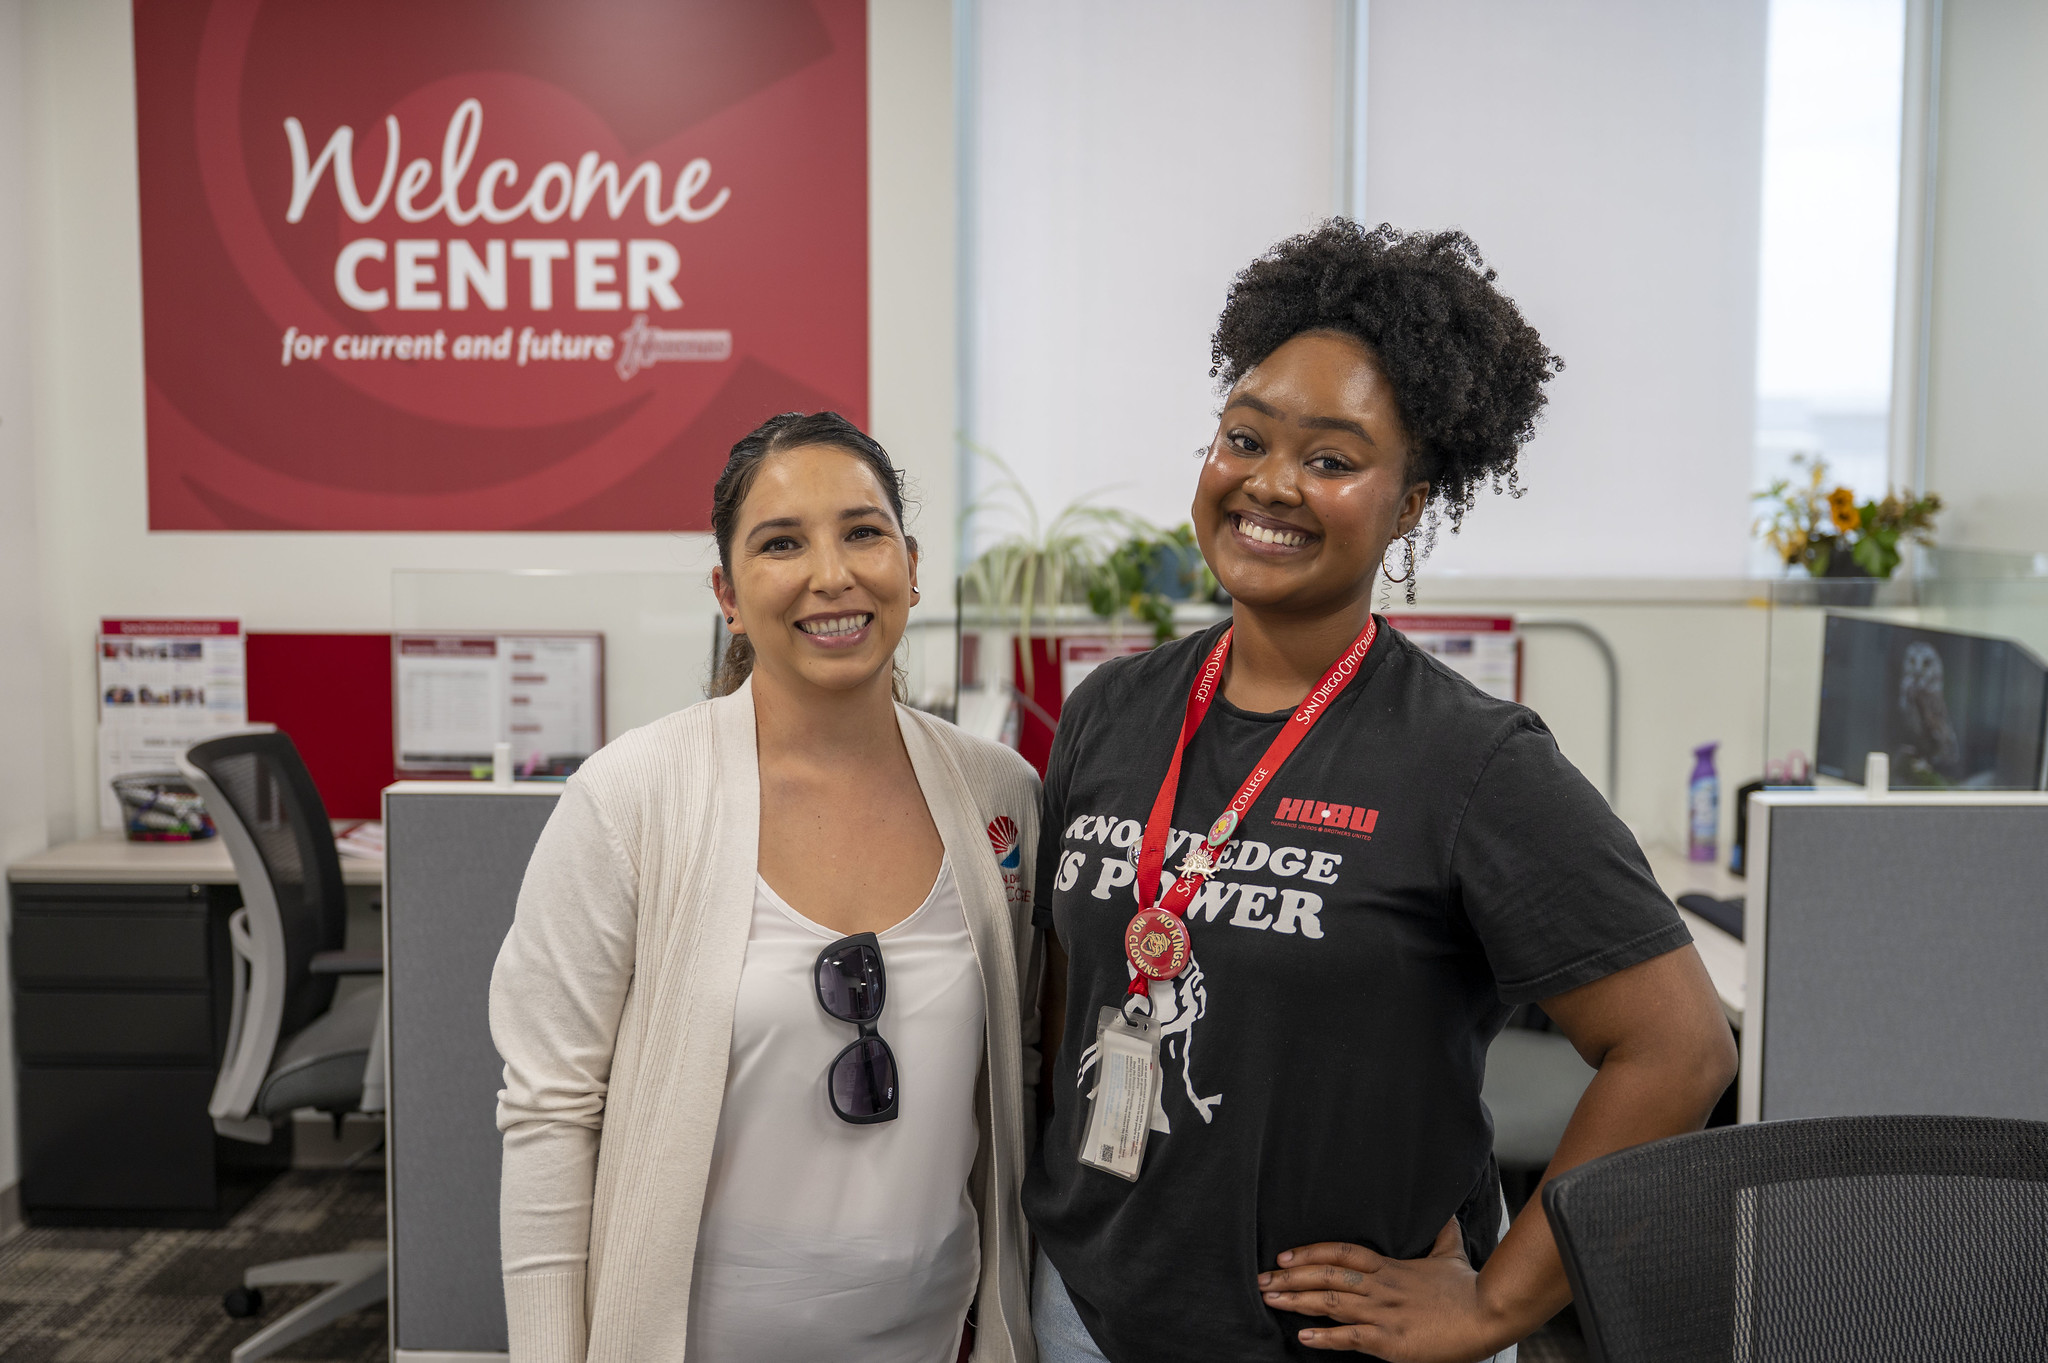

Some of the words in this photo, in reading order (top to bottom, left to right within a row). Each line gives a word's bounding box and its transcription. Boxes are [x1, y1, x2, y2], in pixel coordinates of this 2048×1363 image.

[283, 98, 732, 226] Welcome
[334, 238, 684, 311] CENTER
[281, 327, 329, 365] for
[332, 330, 447, 360] current
[451, 327, 514, 360] and
[516, 327, 616, 366] future
[1195, 661, 1220, 703] COLLEGE
[1296, 701, 1319, 725] SAN
[1312, 671, 1343, 704] DIEGO
[1338, 651, 1359, 675] CITY
[1232, 768, 1269, 812] COLLEGE
[1270, 820, 1297, 829] HERMANOS
[1298, 824, 1317, 832] UNIDOS
[1323, 828, 1351, 838] BROTHERS
[1351, 832, 1372, 841] UNITED
[1274, 797, 1379, 834] HUBU
[1132, 917, 1147, 933] NO
[1156, 913, 1175, 929] NO
[1169, 928, 1184, 969] KINGS.
[1128, 934, 1162, 977] CLOWNS.
